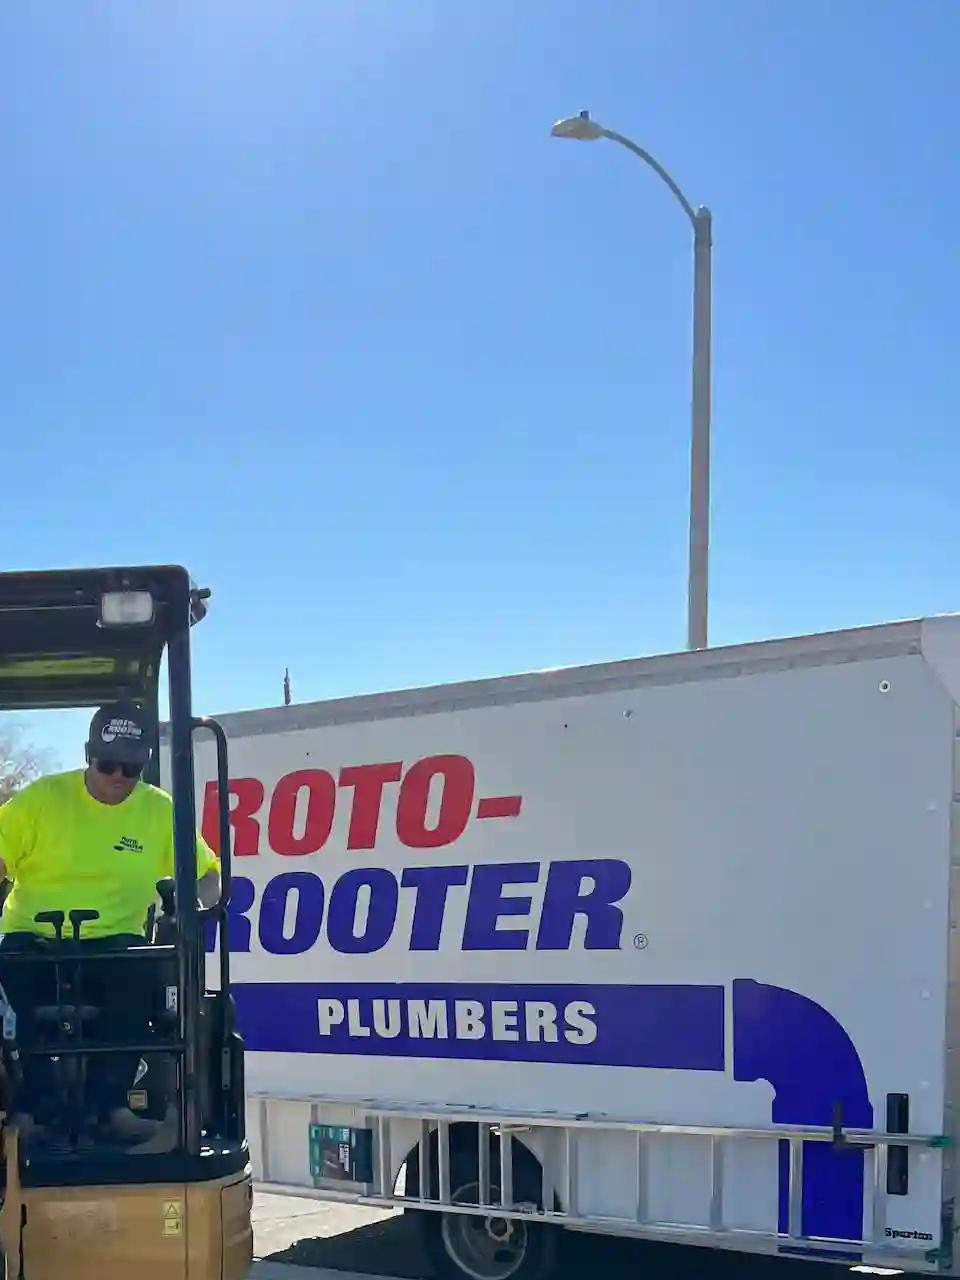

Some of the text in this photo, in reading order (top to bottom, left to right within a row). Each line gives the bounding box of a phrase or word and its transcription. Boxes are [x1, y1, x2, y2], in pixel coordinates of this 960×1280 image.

[200, 753, 523, 857] ROTO-
[203, 858, 632, 955] ROOTER
[317, 998, 599, 1045] PLUMBERS
[884, 1227, 933, 1241] Spartan
